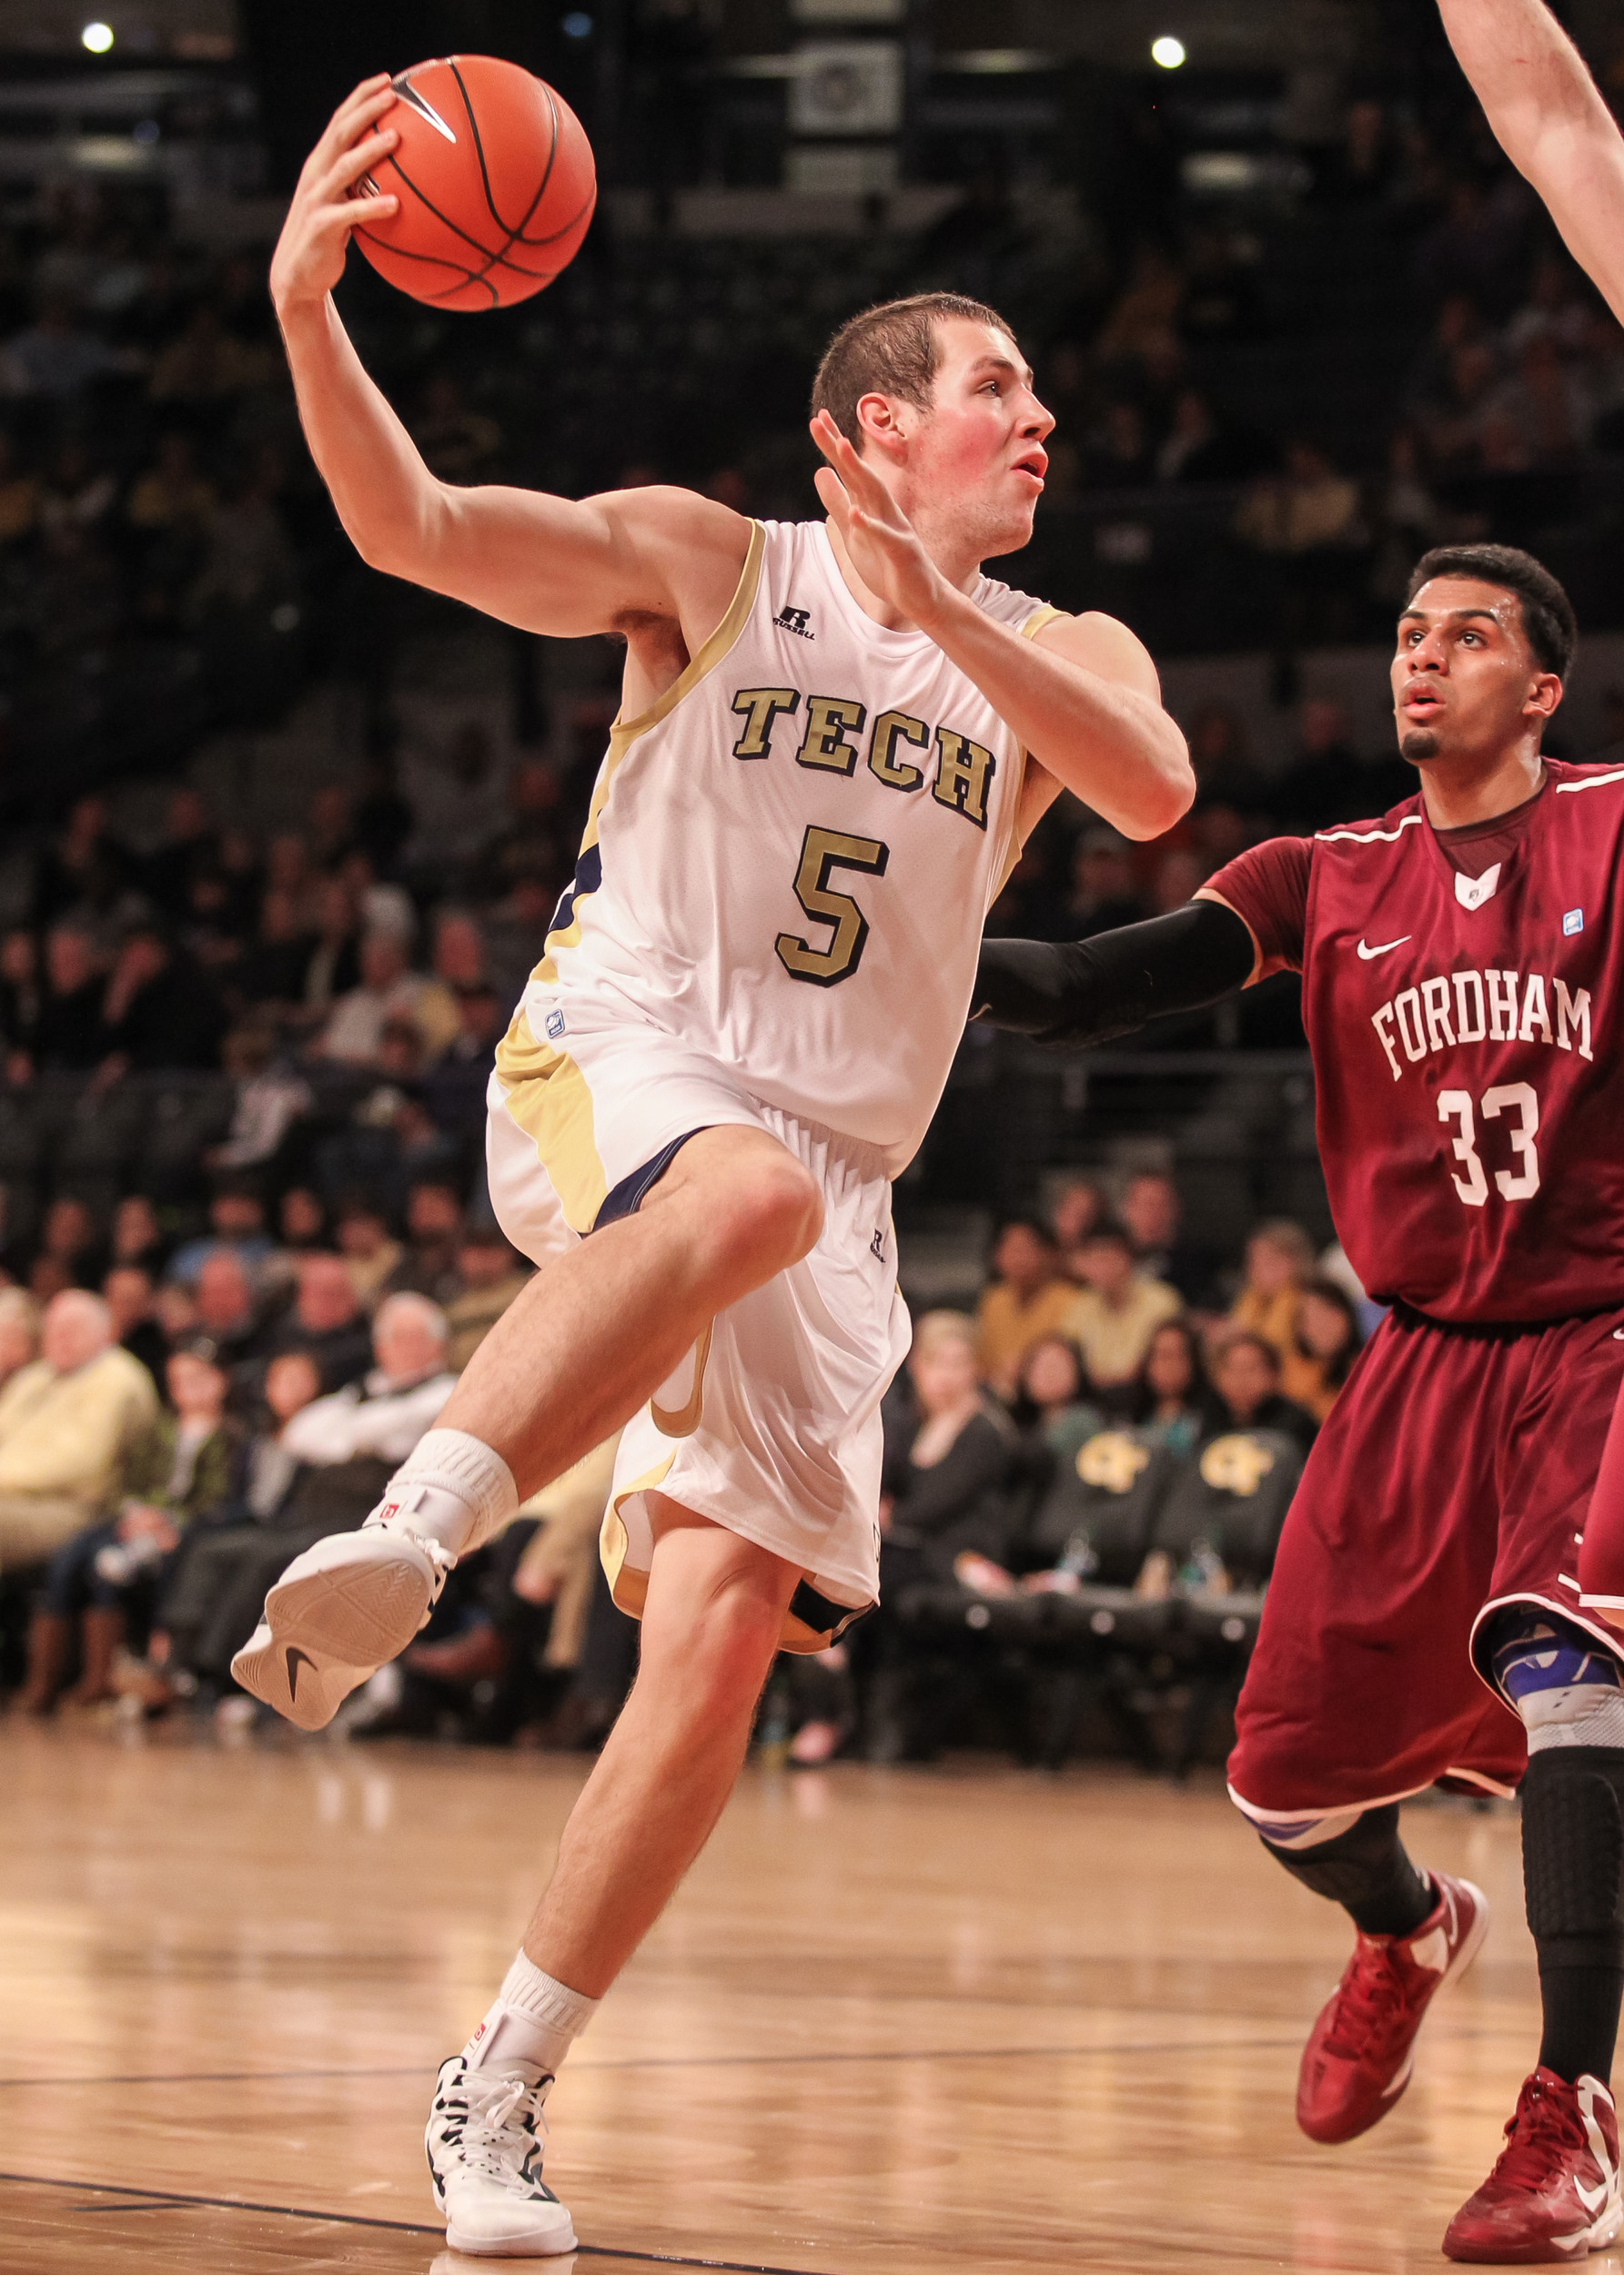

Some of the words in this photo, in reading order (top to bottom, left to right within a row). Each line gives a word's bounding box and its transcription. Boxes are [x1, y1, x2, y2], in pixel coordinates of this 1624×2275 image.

[772, 617, 815, 641] RUSSELL
[780, 605, 811, 630] R
[731, 687, 996, 831] TECH
[774, 824, 890, 988] 5
[1371, 969, 1594, 1082] FORDHAM
[1437, 1081, 1540, 1207] 33
